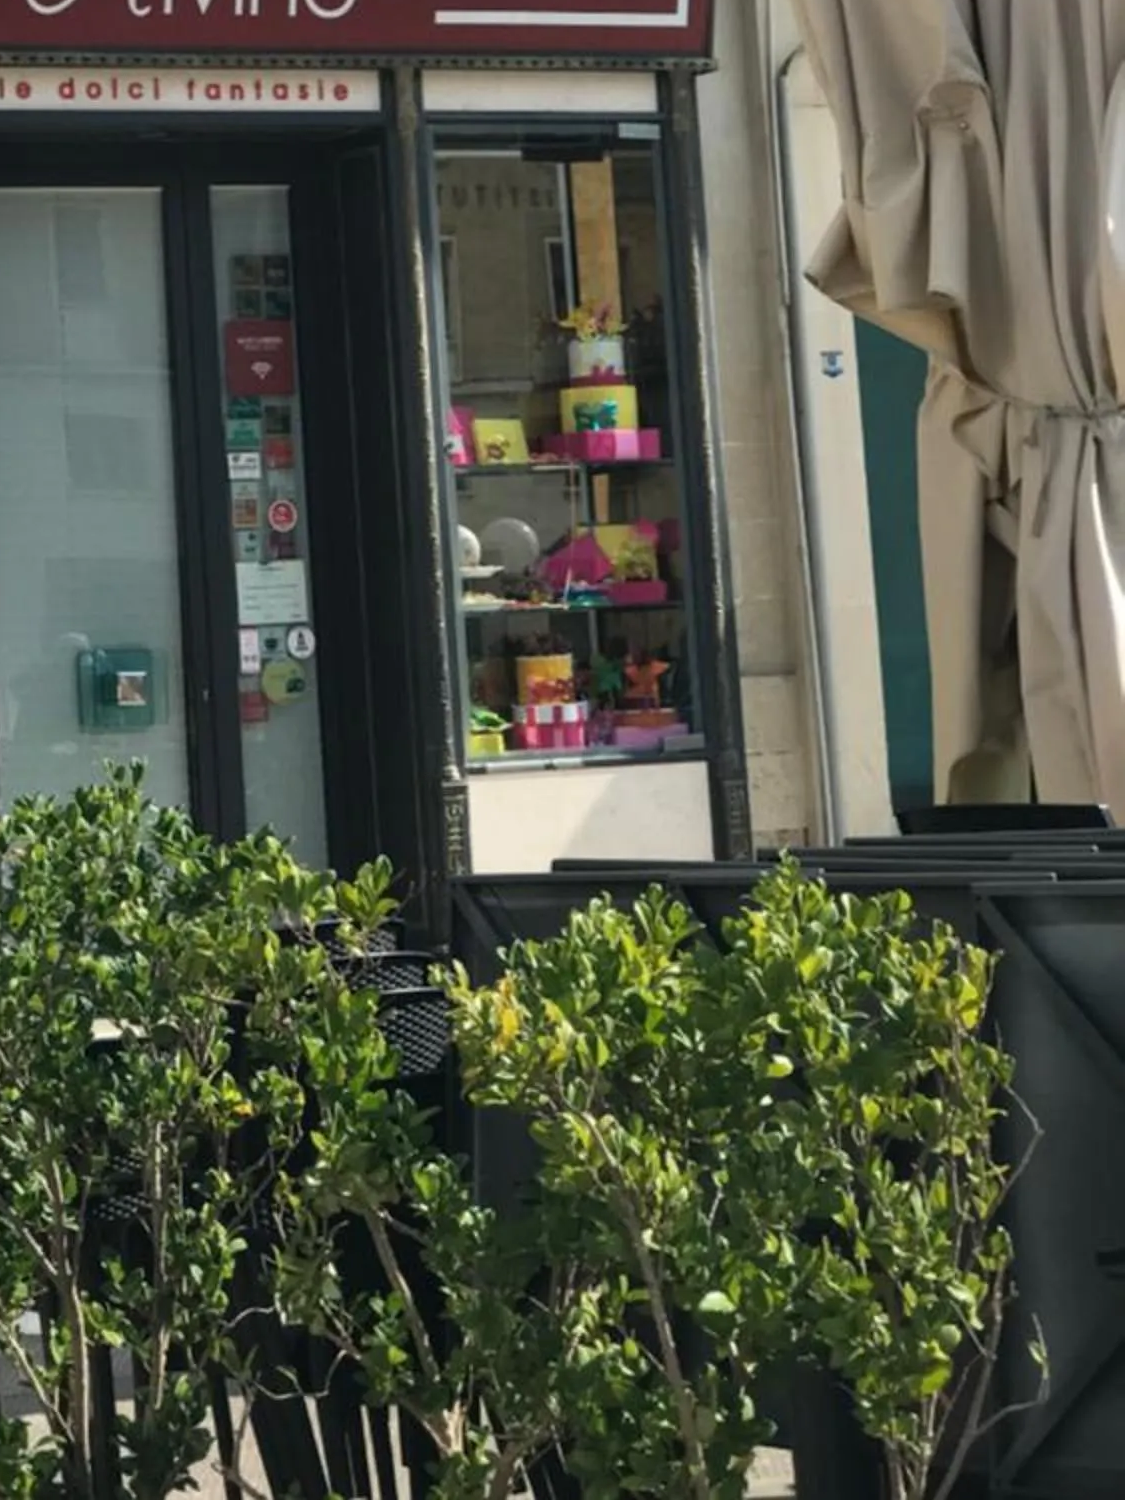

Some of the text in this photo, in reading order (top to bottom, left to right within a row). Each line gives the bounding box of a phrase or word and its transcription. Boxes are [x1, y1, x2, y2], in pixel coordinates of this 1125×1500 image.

[0, 77, 350, 101] le dolci fantasie
